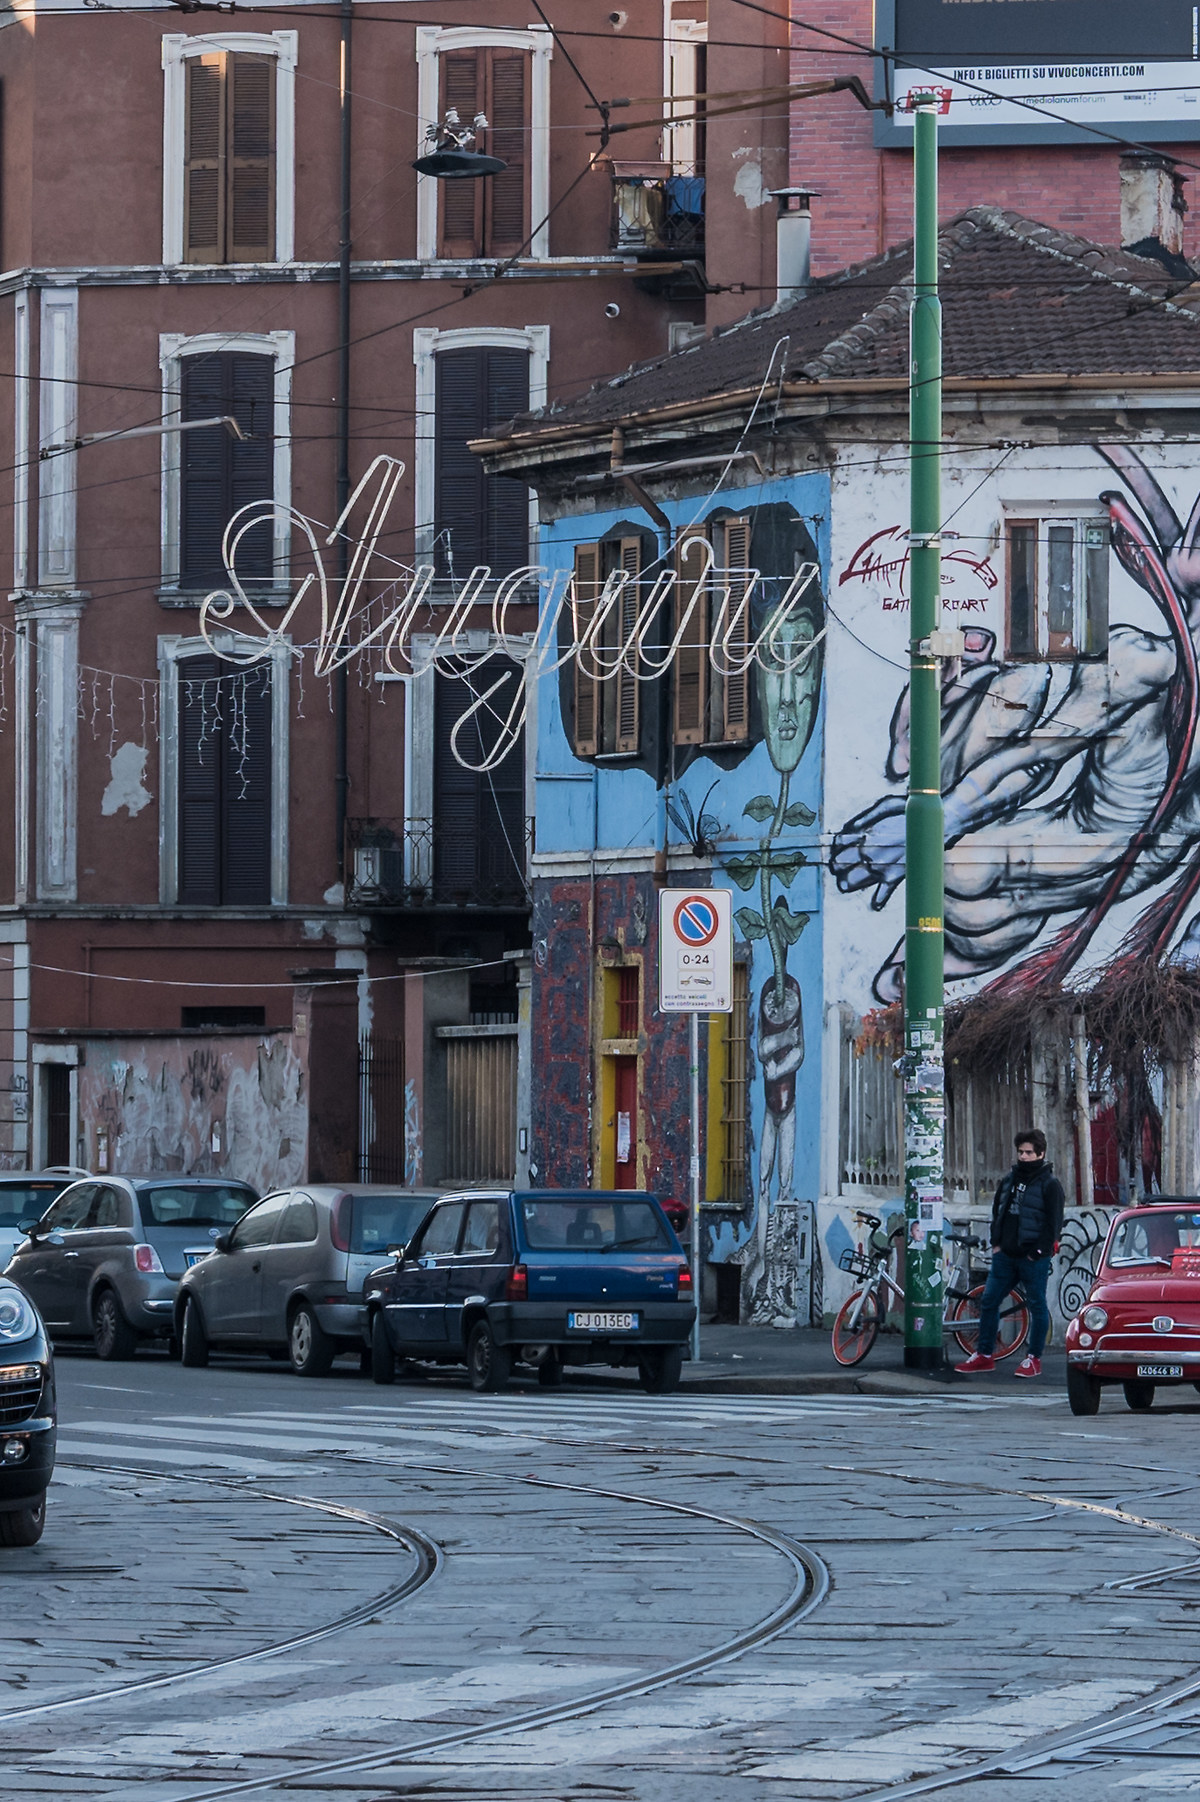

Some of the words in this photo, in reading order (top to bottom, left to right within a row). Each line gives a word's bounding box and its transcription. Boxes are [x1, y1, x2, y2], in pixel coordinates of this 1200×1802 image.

[953, 69, 976, 81] INFO
[978, 69, 984, 80] E
[985, 67, 1030, 80] BIGLIETTI
[1032, 67, 1046, 79] SU
[1048, 65, 1145, 78] VIVOCONCERTI.COM
[199, 454, 830, 771] Auguri
[683, 954, 709, 965] 0-24
